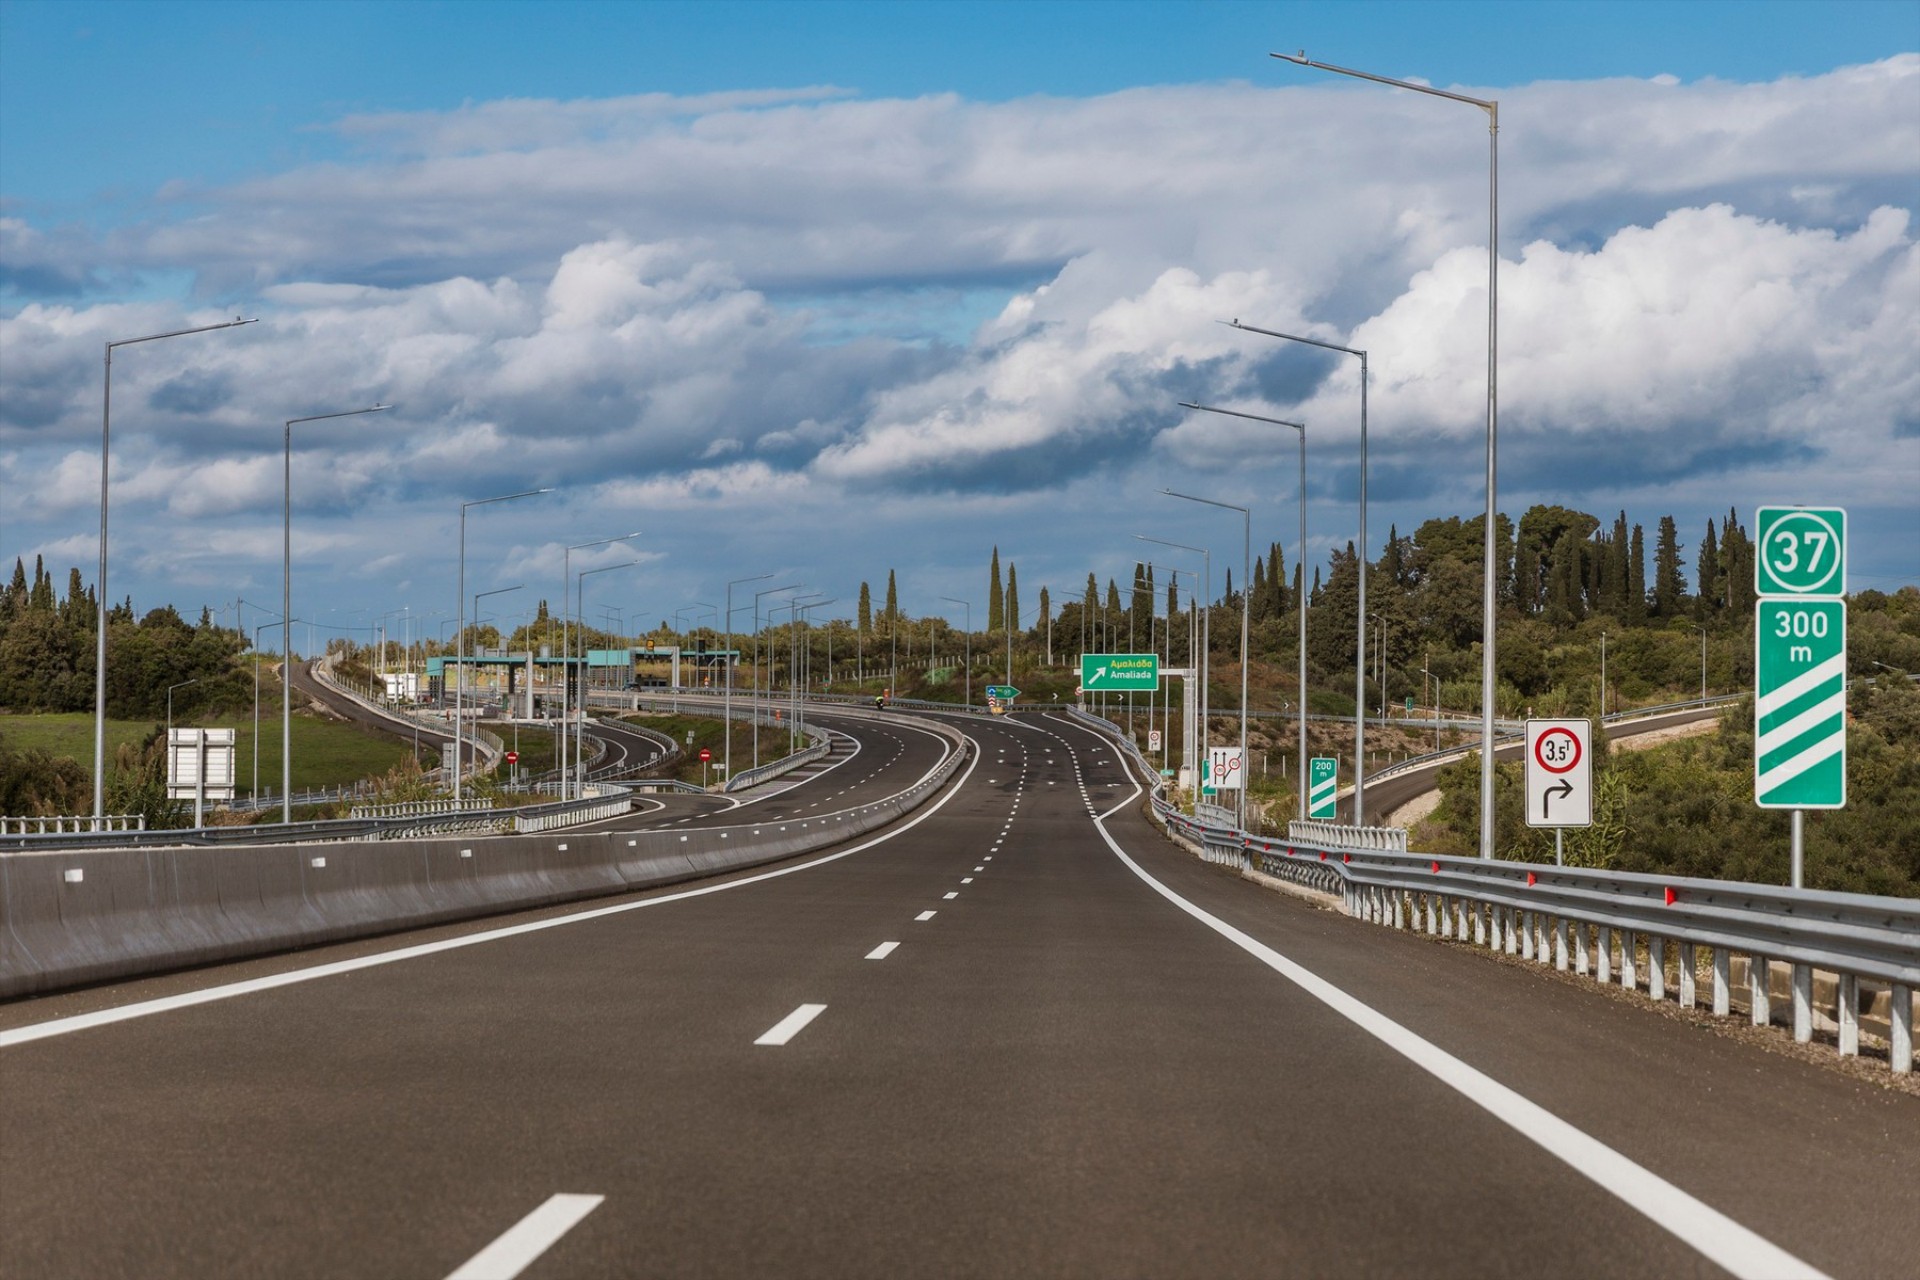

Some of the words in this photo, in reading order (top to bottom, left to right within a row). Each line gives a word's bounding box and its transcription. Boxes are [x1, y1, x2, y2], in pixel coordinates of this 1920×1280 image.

[1774, 531, 1829, 574] 37
[1775, 611, 1828, 638] 300
[1790, 645, 1812, 662] m
[1110, 670, 1152, 679] Amaliada
[1315, 762, 1332, 770] 200
